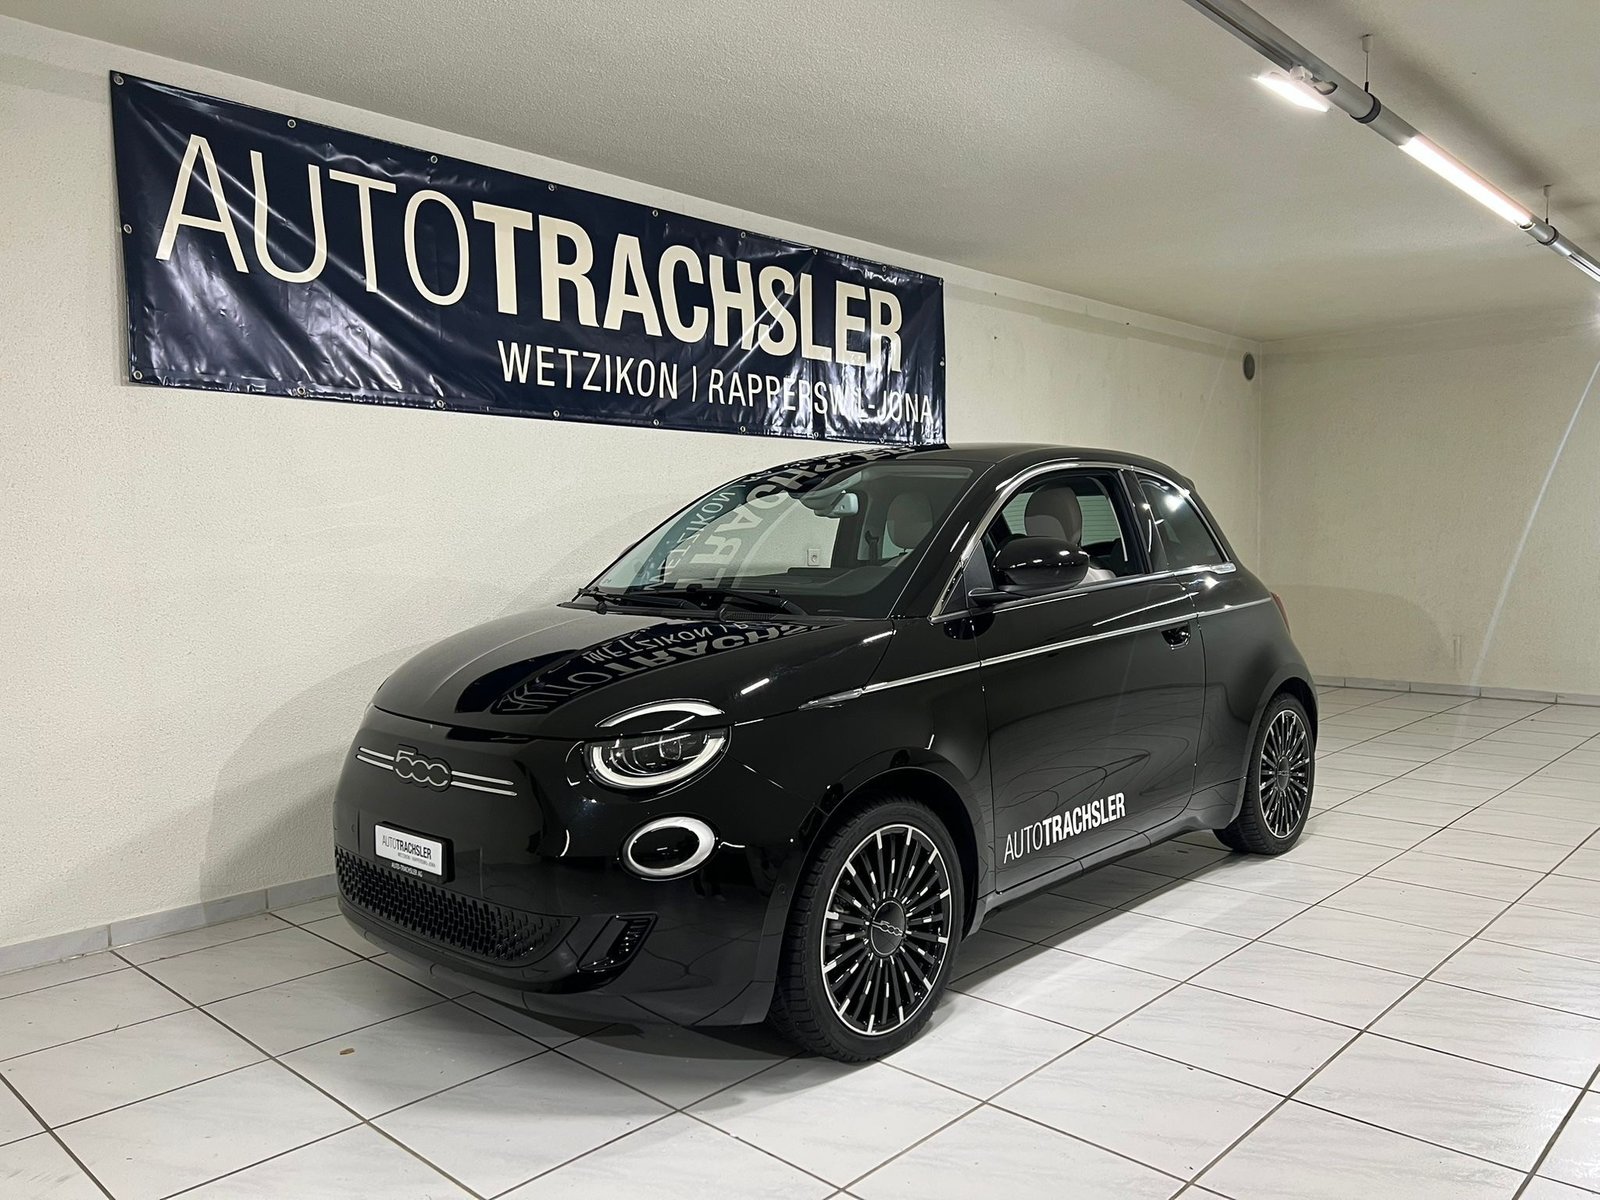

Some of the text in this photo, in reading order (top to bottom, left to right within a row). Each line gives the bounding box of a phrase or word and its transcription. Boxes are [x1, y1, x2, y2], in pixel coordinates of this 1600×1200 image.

[155, 134, 902, 371] AUTOTRACHSLER
[497, 340, 678, 400] WETZIKON
[708, 368, 933, 423] RAPPERSWL-JONA
[396, 750, 449, 786] 500
[382, 835, 432, 860] AUTOTRACHSLER
[1003, 792, 1126, 864] AUTOTRACHSLER
